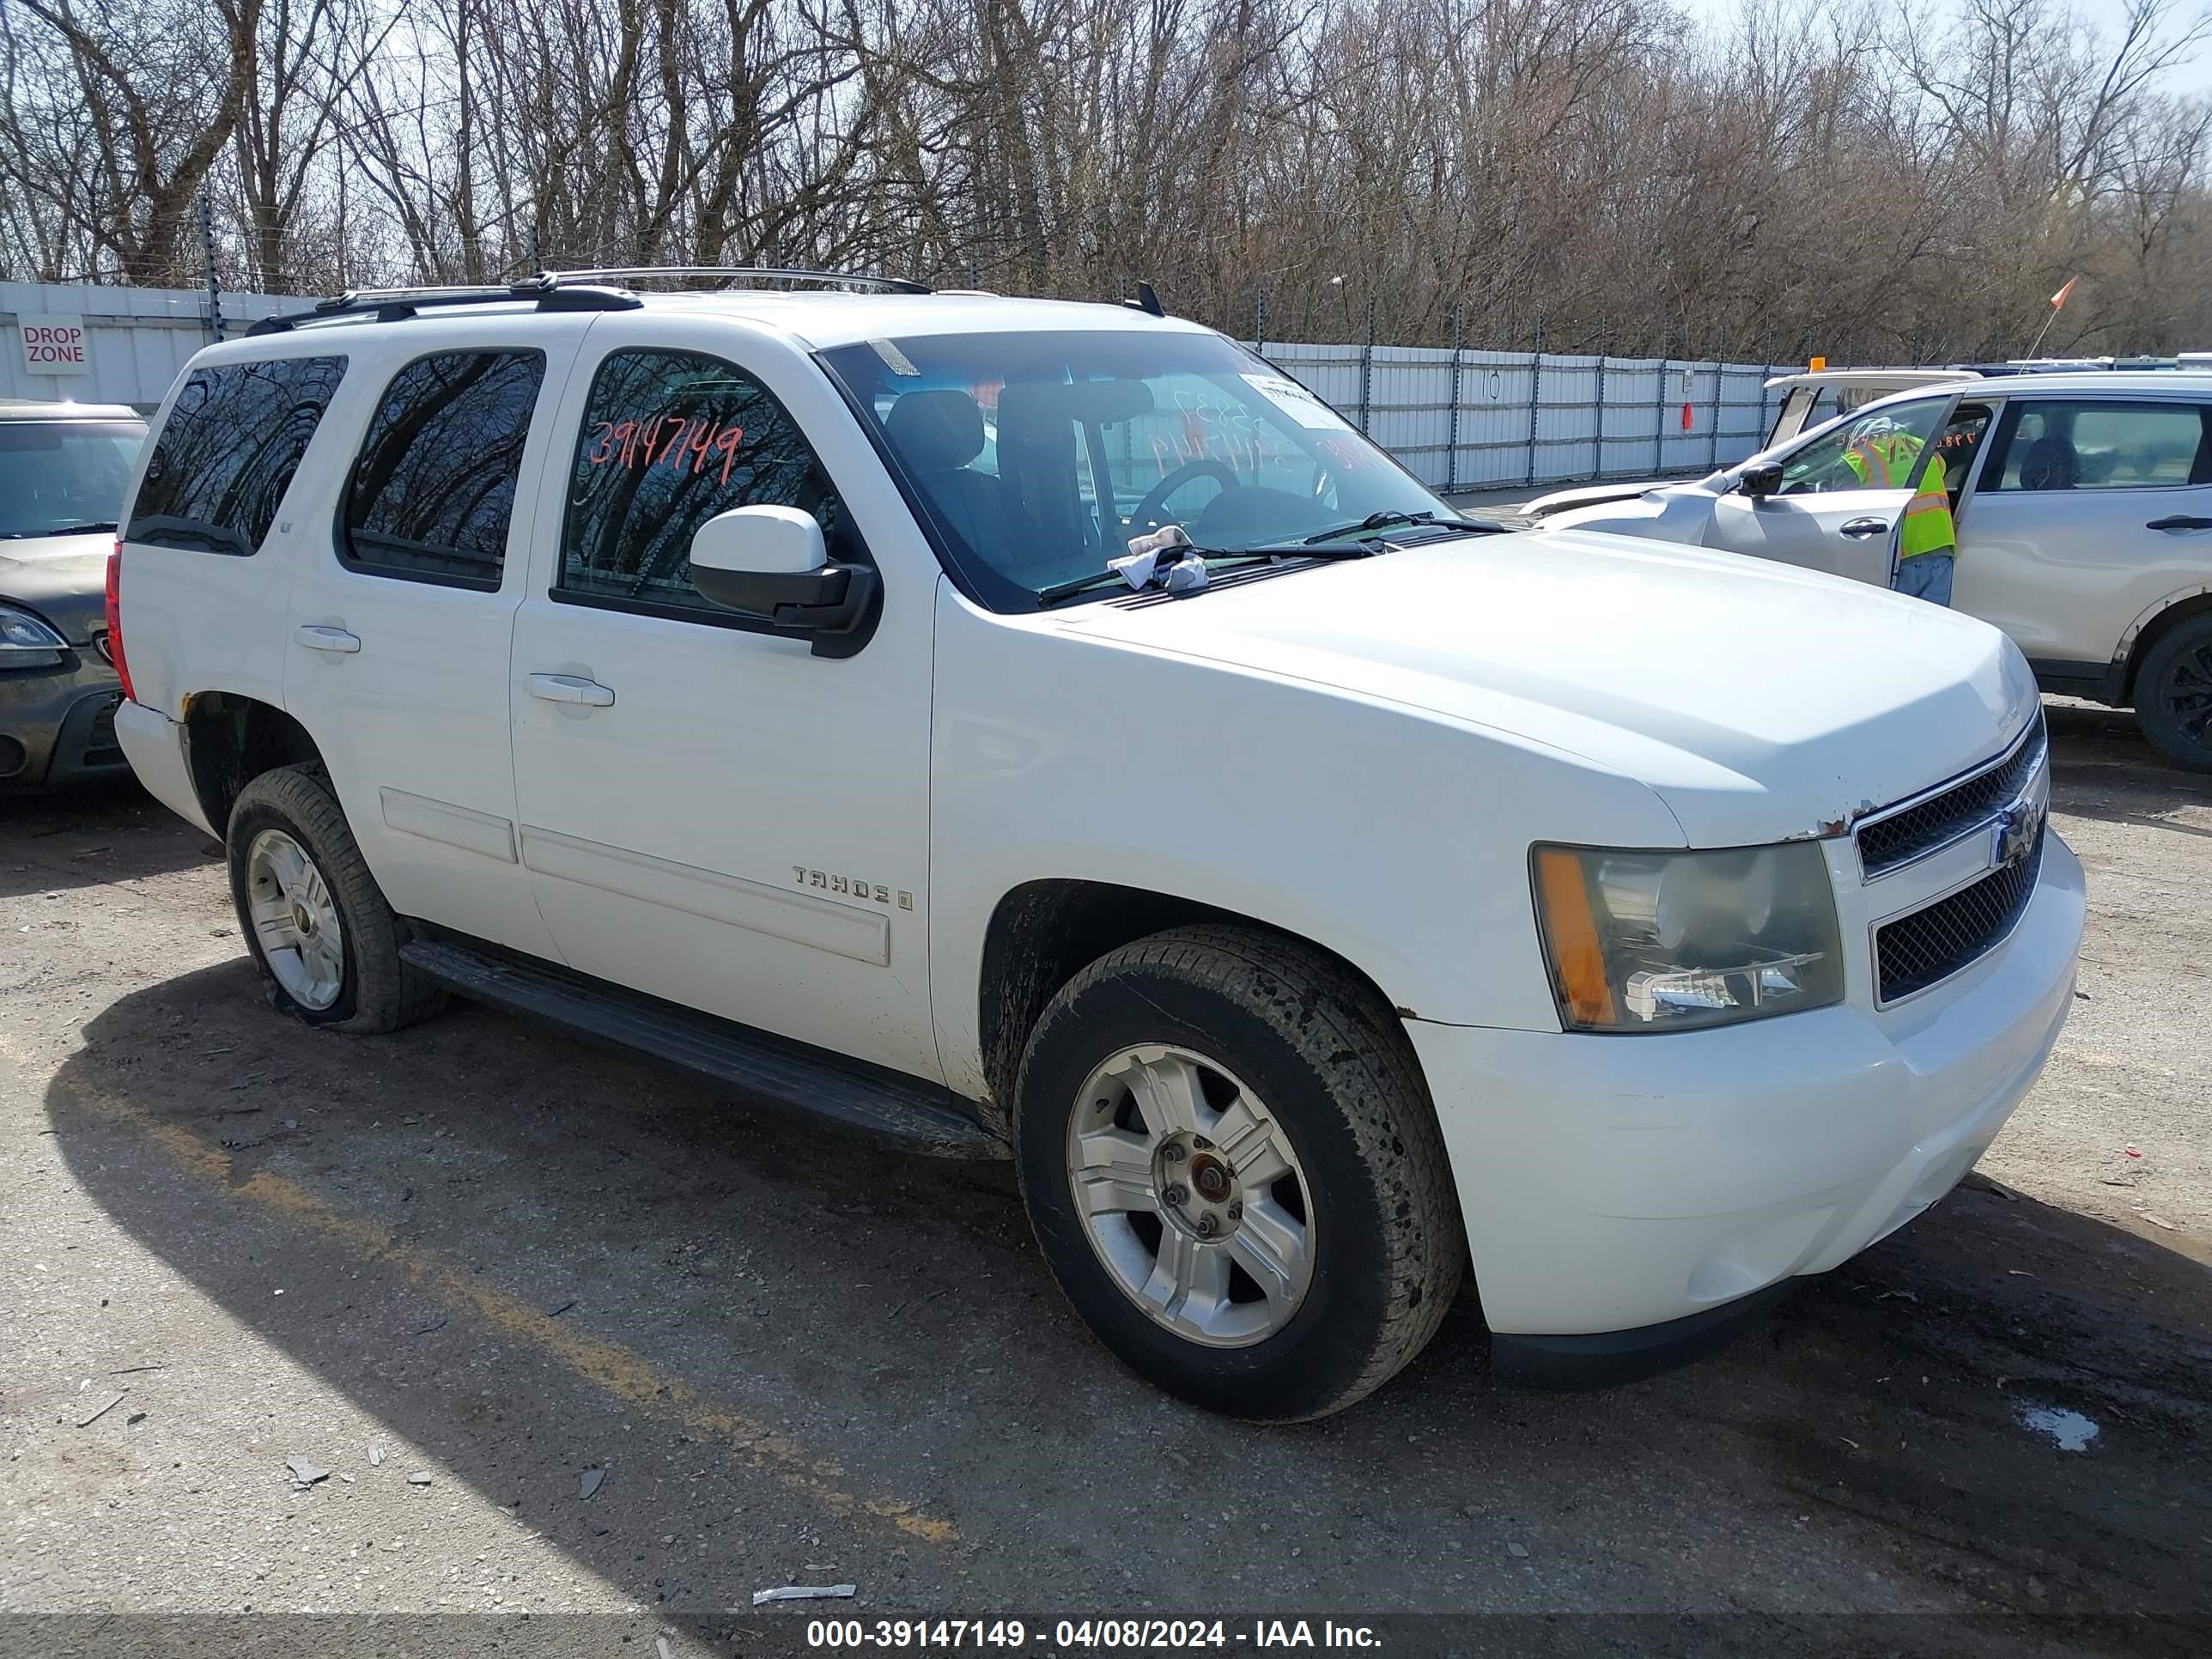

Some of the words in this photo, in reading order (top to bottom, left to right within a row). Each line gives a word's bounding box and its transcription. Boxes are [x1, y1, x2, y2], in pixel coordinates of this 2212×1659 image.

[24, 327, 81, 343] DROP
[27, 346, 84, 362] ZONE
[591, 416, 743, 486] 39147149
[792, 866, 890, 903] TAHOE
